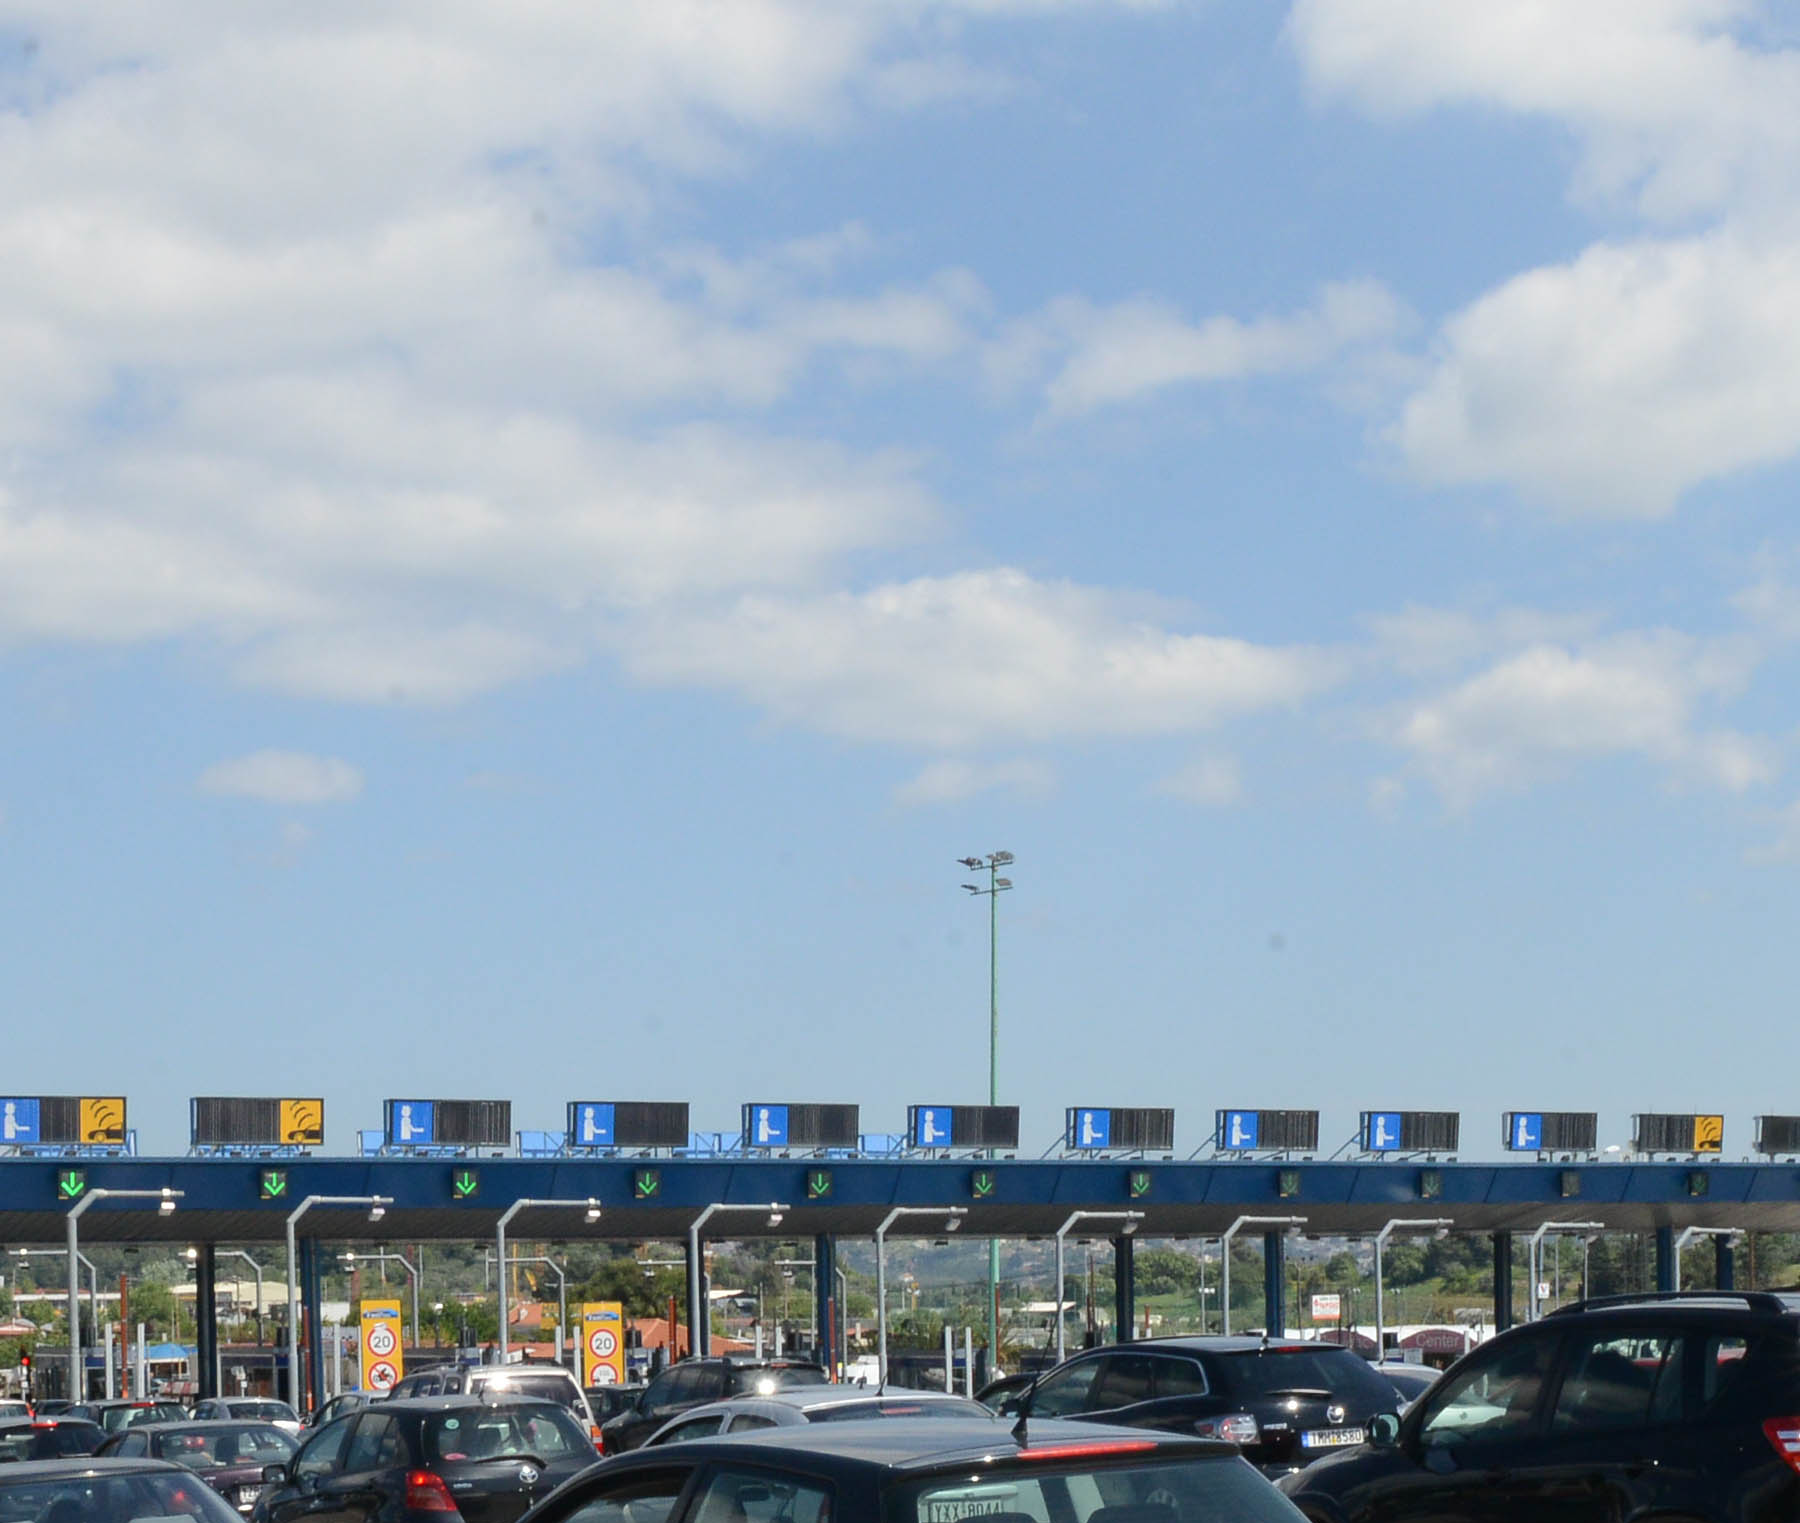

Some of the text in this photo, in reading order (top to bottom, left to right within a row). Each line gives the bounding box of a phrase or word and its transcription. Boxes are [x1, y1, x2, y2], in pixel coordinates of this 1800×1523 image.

[373, 1336, 391, 1348] 20
[595, 1337, 612, 1350] 20
[1416, 1333, 1459, 1347] Center
